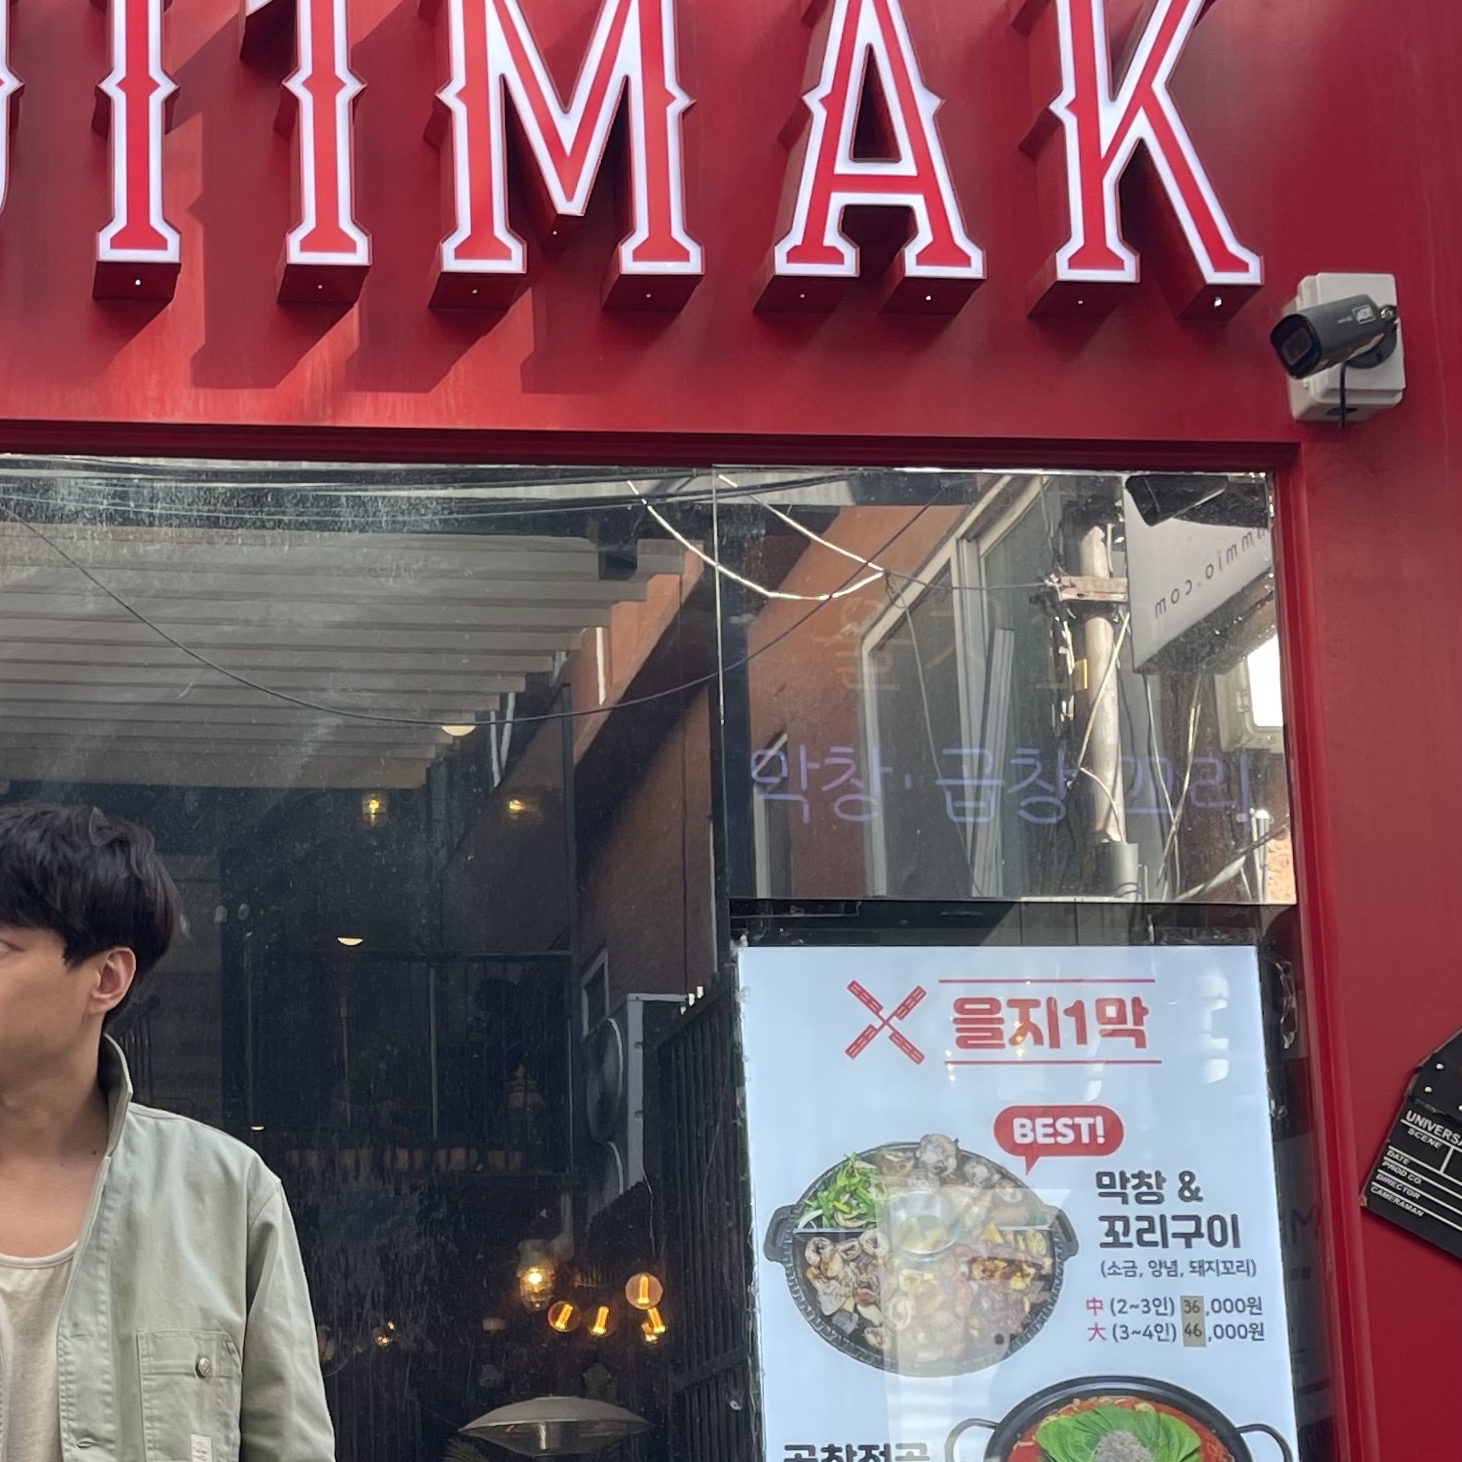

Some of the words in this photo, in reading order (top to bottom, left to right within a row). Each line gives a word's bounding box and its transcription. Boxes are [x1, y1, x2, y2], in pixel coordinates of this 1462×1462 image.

[952, 996, 1149, 1050] 을지1막
[1013, 1116, 1105, 1145] BEST!
[1408, 1128, 1442, 1149] SCENE
[1382, 1161, 1407, 1177] PROD
[1387, 1150, 1410, 1165] DATE
[1095, 1169, 1167, 1205] 막창
[1177, 1170, 1204, 1203] &
[1376, 1174, 1421, 1199] DIRECTOR
[1371, 1187, 1424, 1216] CAMERAMAN
[1098, 1213, 1241, 1250] 꼬리구이
[1100, 1259, 1144, 1279] (소금,
[1147, 1259, 1184, 1278] 양념,
[1189, 1258, 1257, 1278] 돼지꼬리)
[1085, 1296, 1104, 1317] 中
[1109, 1296, 1175, 1318] (2~3인)
[1180, 1295, 1263, 1317] 36,000원
[1087, 1322, 1108, 1342] 大
[1112, 1322, 1177, 1344] (3~4인)
[1183, 1322, 1265, 1343] 46,000원
